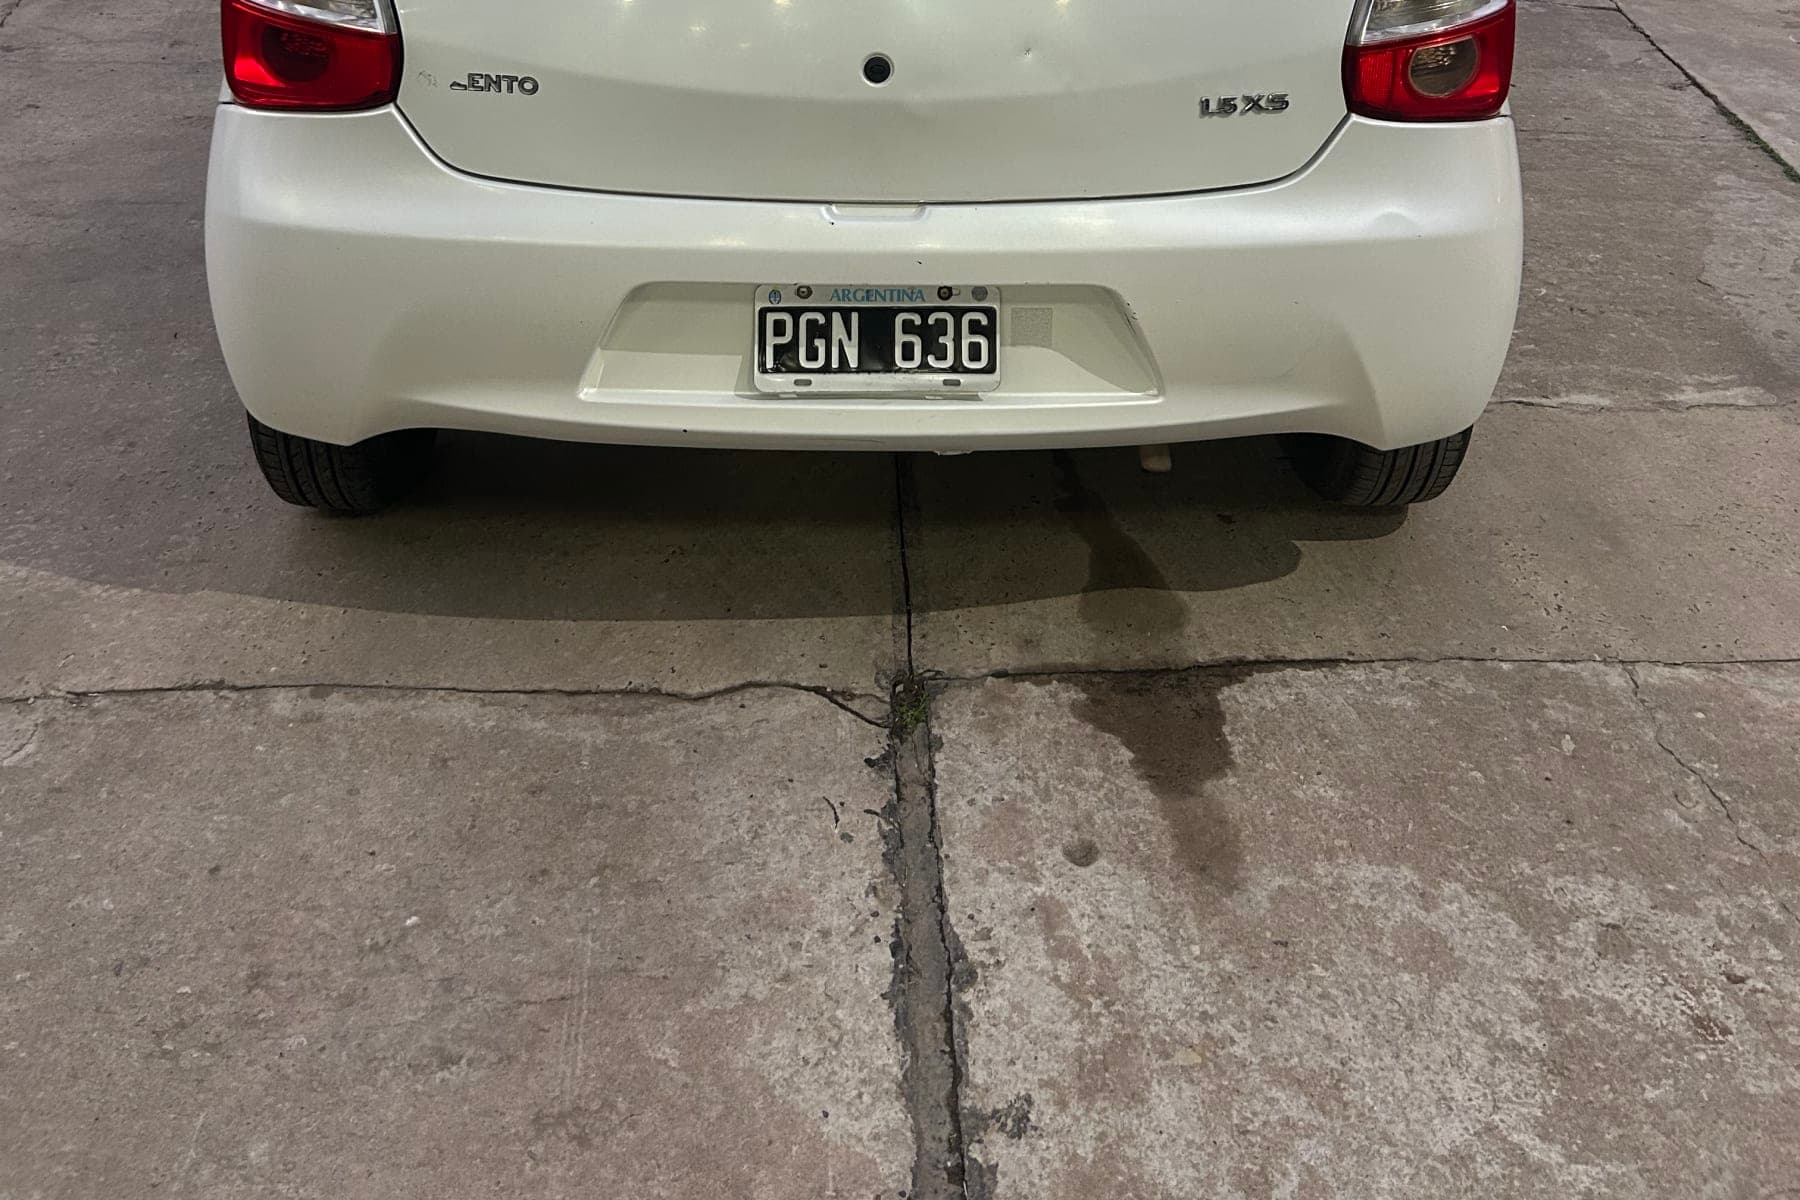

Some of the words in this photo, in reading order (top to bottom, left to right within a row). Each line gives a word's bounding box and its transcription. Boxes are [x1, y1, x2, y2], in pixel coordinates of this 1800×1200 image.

[1240, 93, 1290, 115] XS
[830, 287, 925, 303] ARGENTINA
[765, 311, 859, 369] PGN
[895, 311, 989, 369] 636
